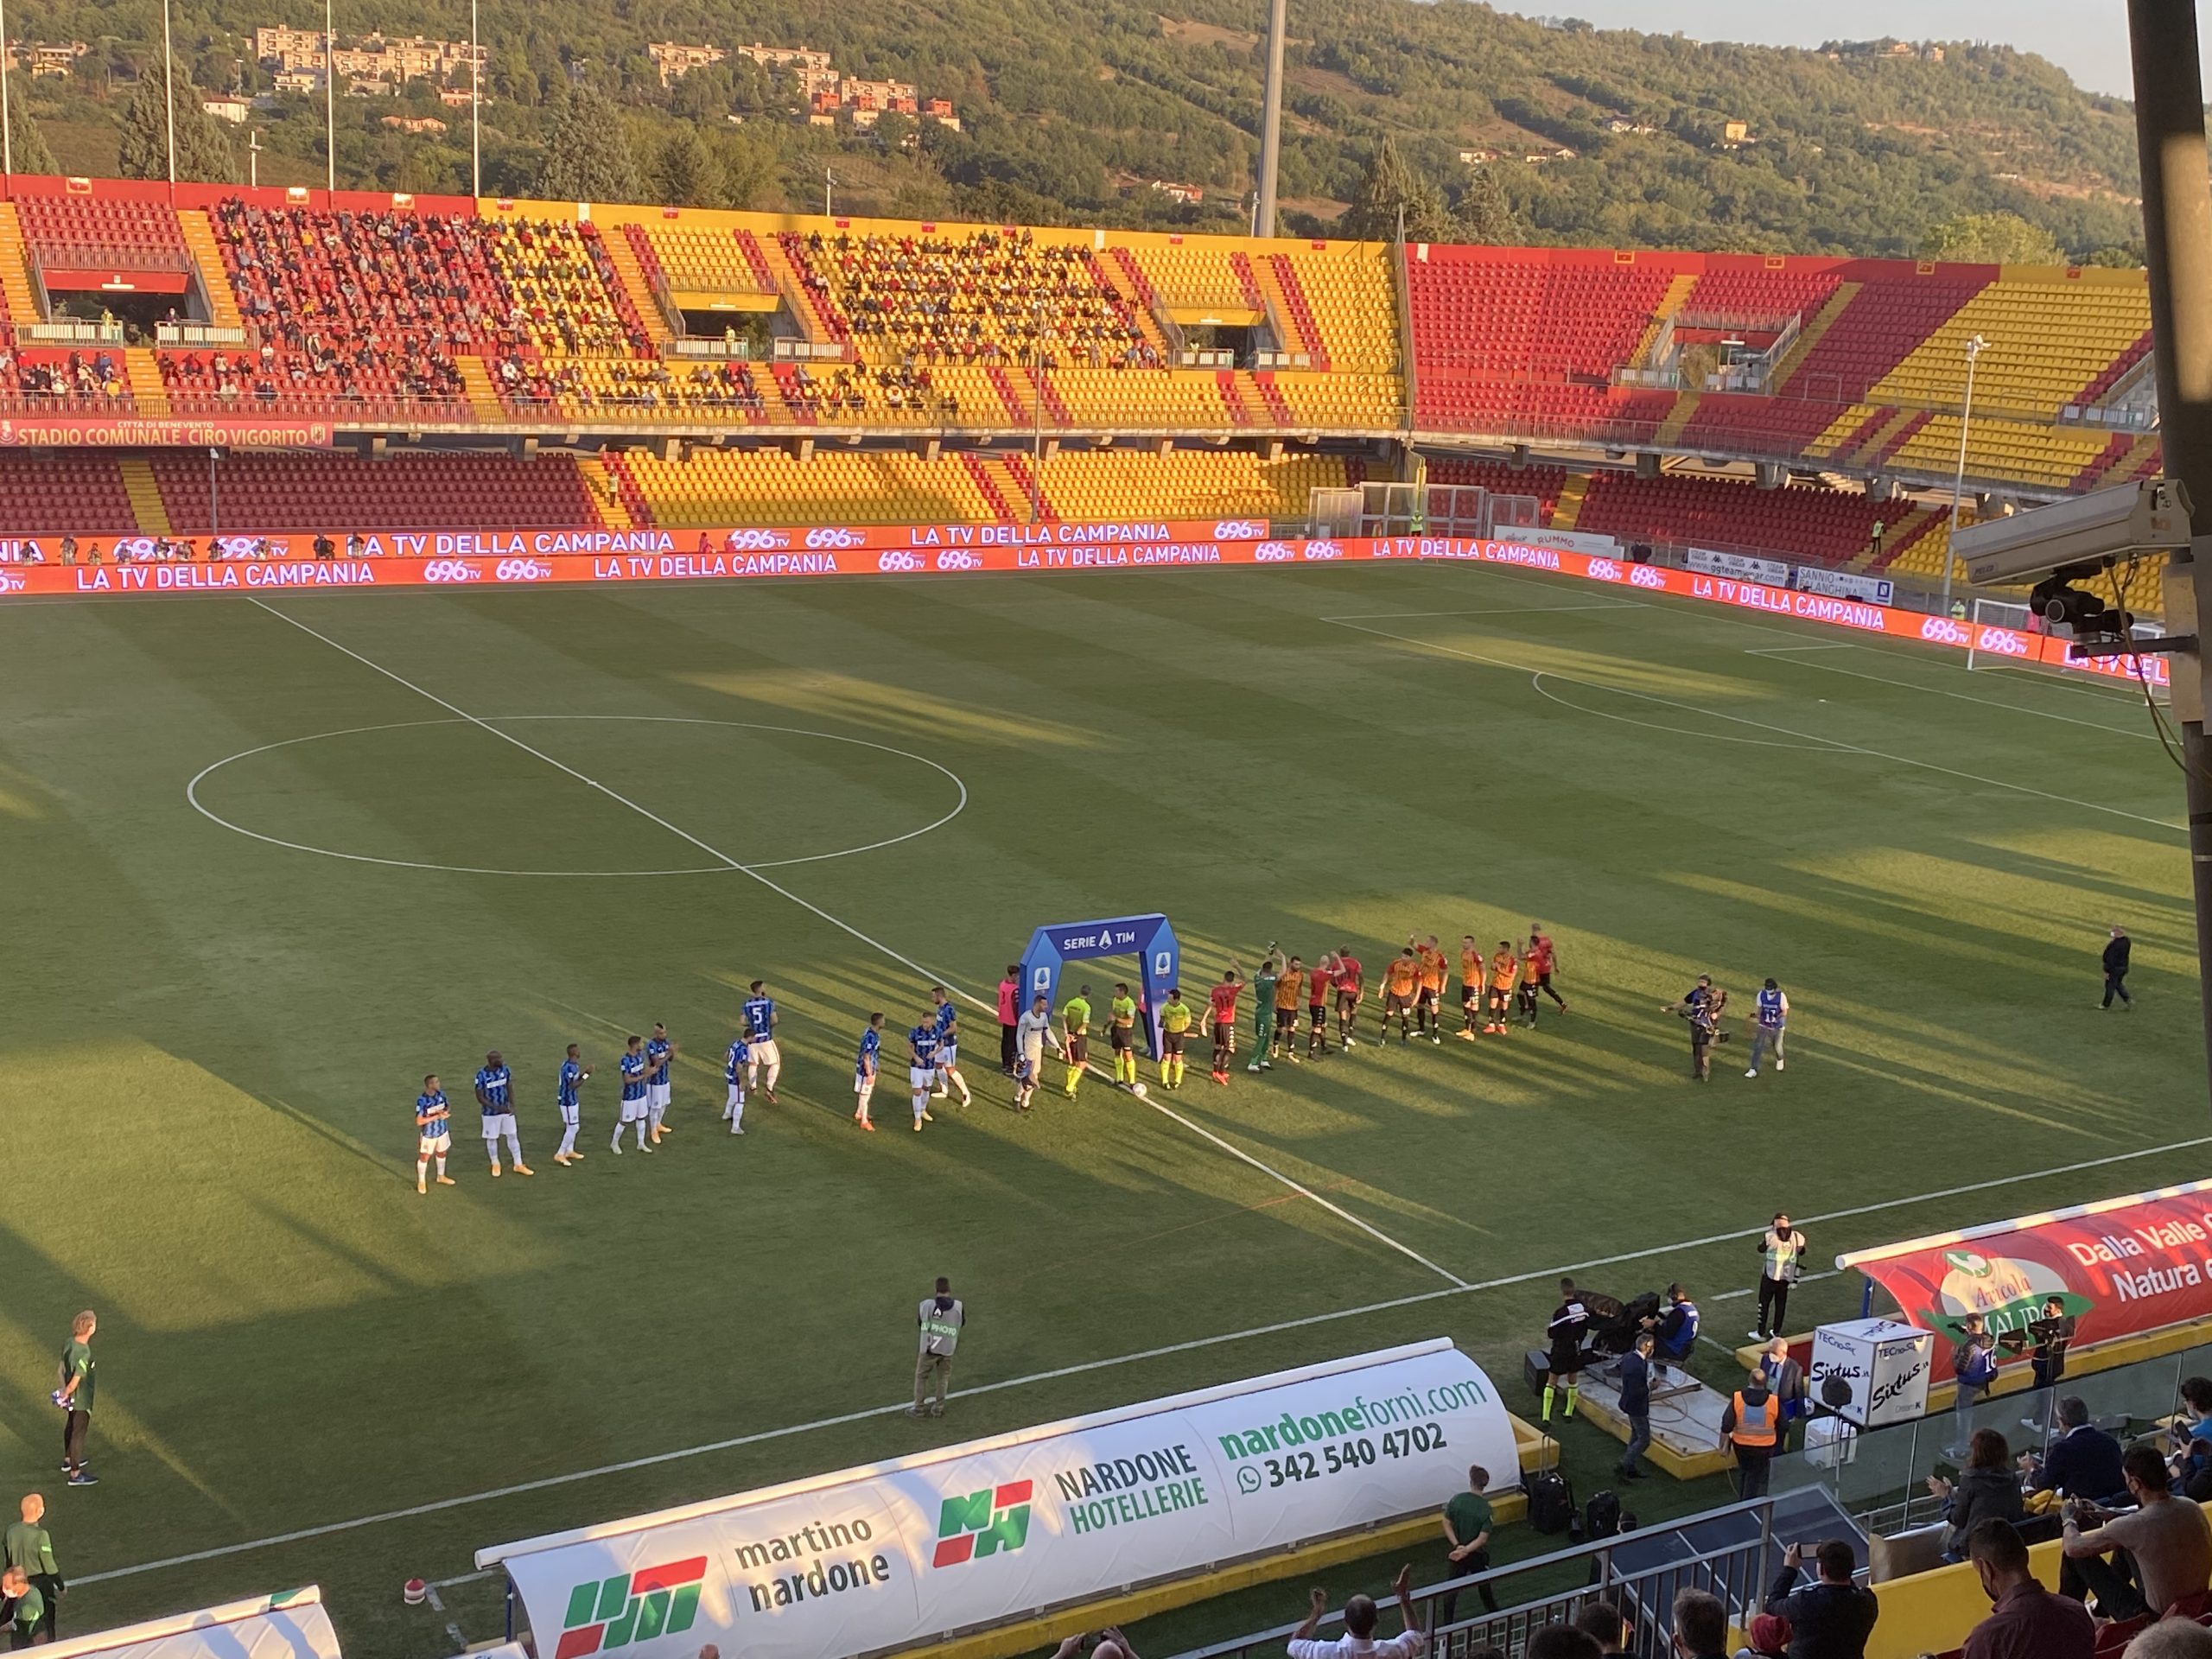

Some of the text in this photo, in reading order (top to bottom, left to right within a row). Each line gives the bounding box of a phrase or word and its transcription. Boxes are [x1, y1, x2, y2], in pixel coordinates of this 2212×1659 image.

[18, 429, 308, 445] STADIO COMUNALE CIRO VIGORITO
[391, 535, 427, 556] TV
[435, 534, 527, 556] DELLA
[534, 531, 676, 554] CAMPANIA
[911, 523, 1172, 545] LA TV DELLA CAMPANIA
[1536, 536, 1575, 548] RUMMO
[594, 553, 837, 578] LA TV DELLA CAMPANIA
[1017, 543, 1221, 568] LA TV DELLA CAMPANIA
[1373, 540, 1391, 557] LA
[1395, 539, 1415, 556] TV
[1420, 539, 1480, 558] DELLA
[1484, 541, 1560, 569] CAMPANIA
[77, 563, 375, 590] LA TV DELLA CAMPANIA
[1800, 569, 1834, 583] SANNIO
[1693, 576, 1713, 597] LA
[1718, 580, 1738, 601] TV
[1739, 584, 1791, 613] DELLA
[1796, 594, 1885, 630] CAMPANIA
[1064, 936, 1096, 950] SERIE
[1116, 931, 1135, 944] TIM
[752, 1007, 762, 1024] 5
[2066, 1221, 2208, 1267] Dalla Valle
[2112, 1263, 2202, 1302] Natura
[931, 1323, 957, 1337] PHOTO
[1217, 1376, 1488, 1460] nardoneforni.com
[1264, 1421, 1447, 1488] 342 540 4702
[1055, 1444, 1198, 1501] NARDONE
[1069, 1476, 1210, 1535] HOTELLERIE
[734, 1518, 873, 1569] martino
[748, 1553, 890, 1612] nardone
